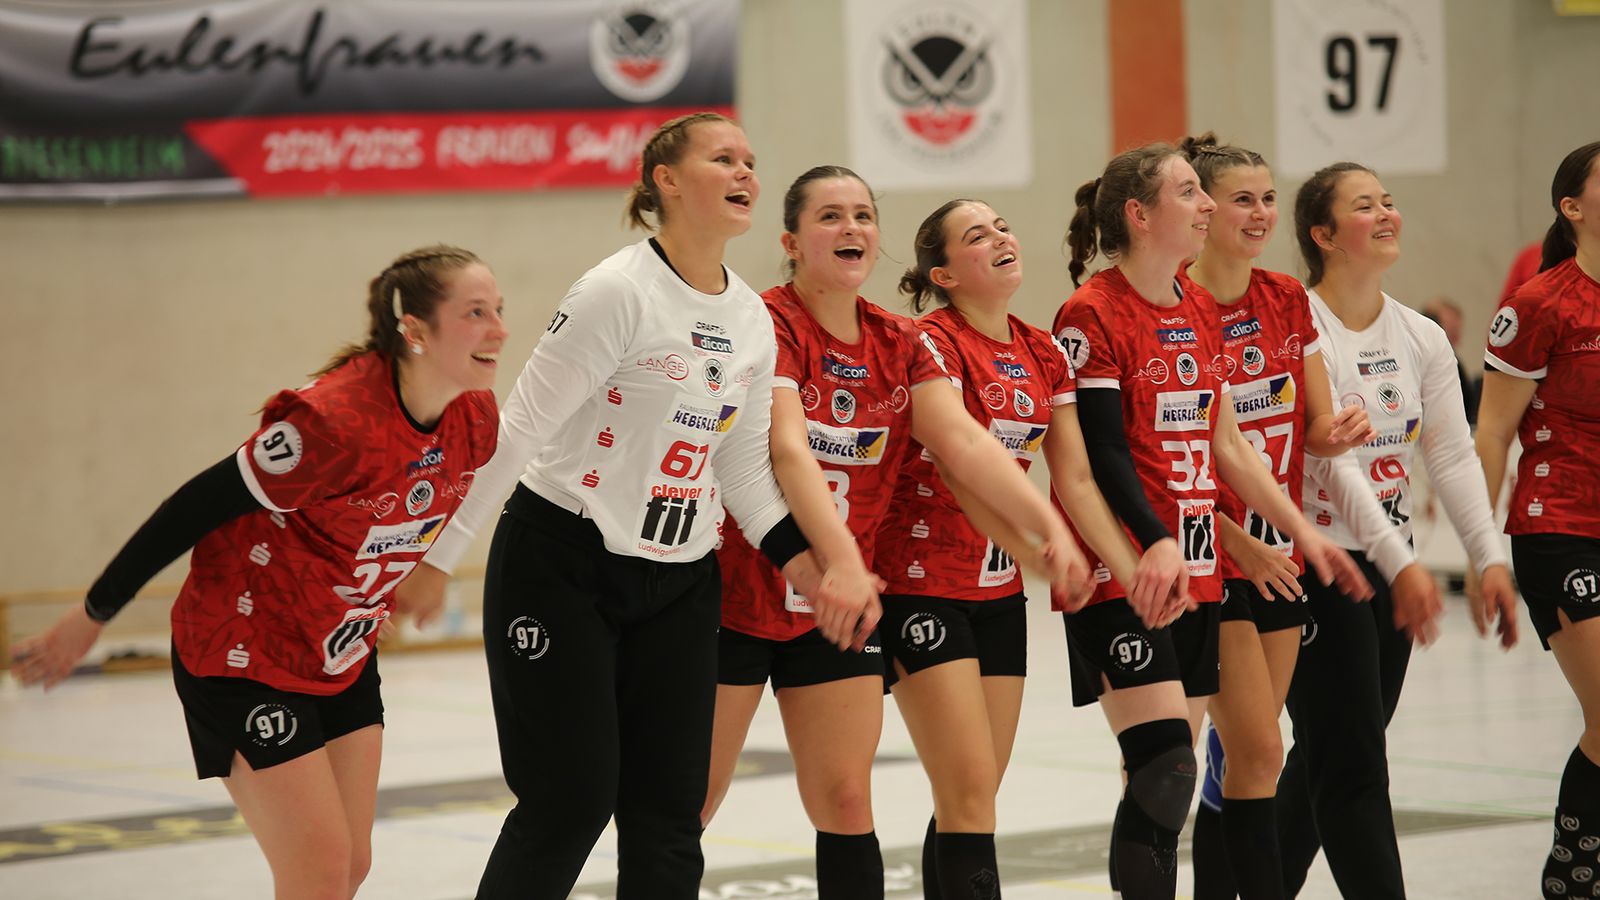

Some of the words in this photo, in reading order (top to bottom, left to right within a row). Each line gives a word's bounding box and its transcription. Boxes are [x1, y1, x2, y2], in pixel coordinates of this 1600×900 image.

[70, 9, 545, 96] Eulenfrauen
[1324, 35, 1400, 113] 97
[1490, 314, 1513, 338] 97
[1233, 395, 1271, 413] EBERLE
[263, 430, 294, 461] 97
[1161, 440, 1216, 491] 32
[651, 484, 702, 499] clever
[640, 496, 697, 546] fit
[333, 561, 417, 605] 27
[1572, 574, 1596, 597] 97
[516, 626, 539, 649] 97
[909, 619, 935, 645] 97
[1118, 640, 1142, 664] 97
[255, 710, 285, 739] 97
